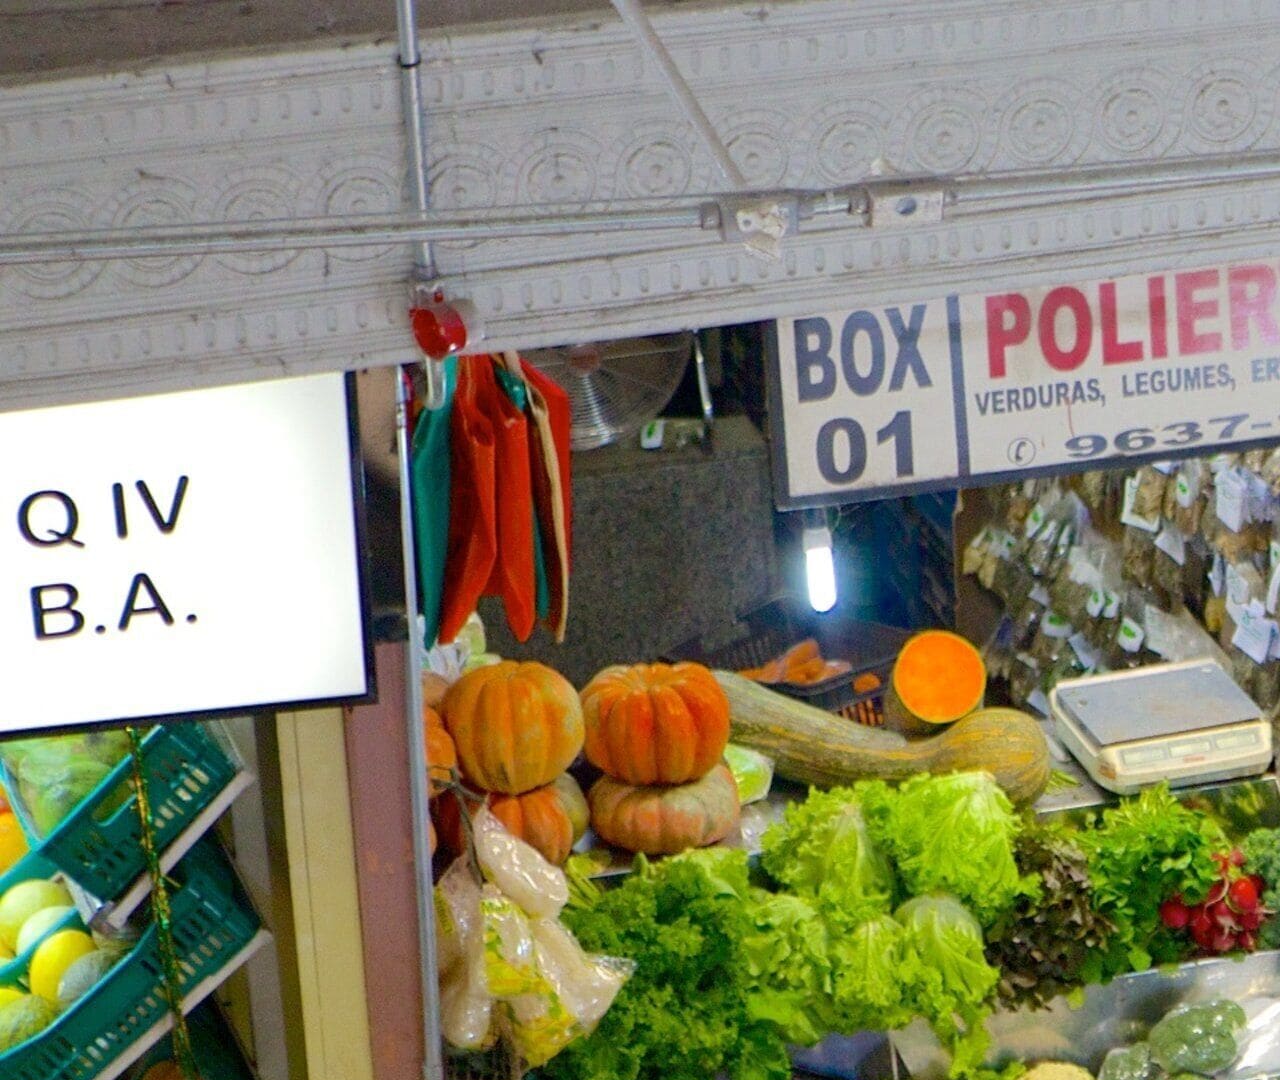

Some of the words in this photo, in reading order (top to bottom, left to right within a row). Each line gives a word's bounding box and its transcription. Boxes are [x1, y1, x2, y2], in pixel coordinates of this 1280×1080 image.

[793, 304, 933, 403] BOX
[975, 378, 1106, 416] VERDURAS,
[1121, 363, 1237, 397] LEGUMES,
[816, 410, 914, 485] 01
[17, 490, 86, 548] Q
[112, 475, 189, 539] IV
[30, 572, 197, 641] B.A.
